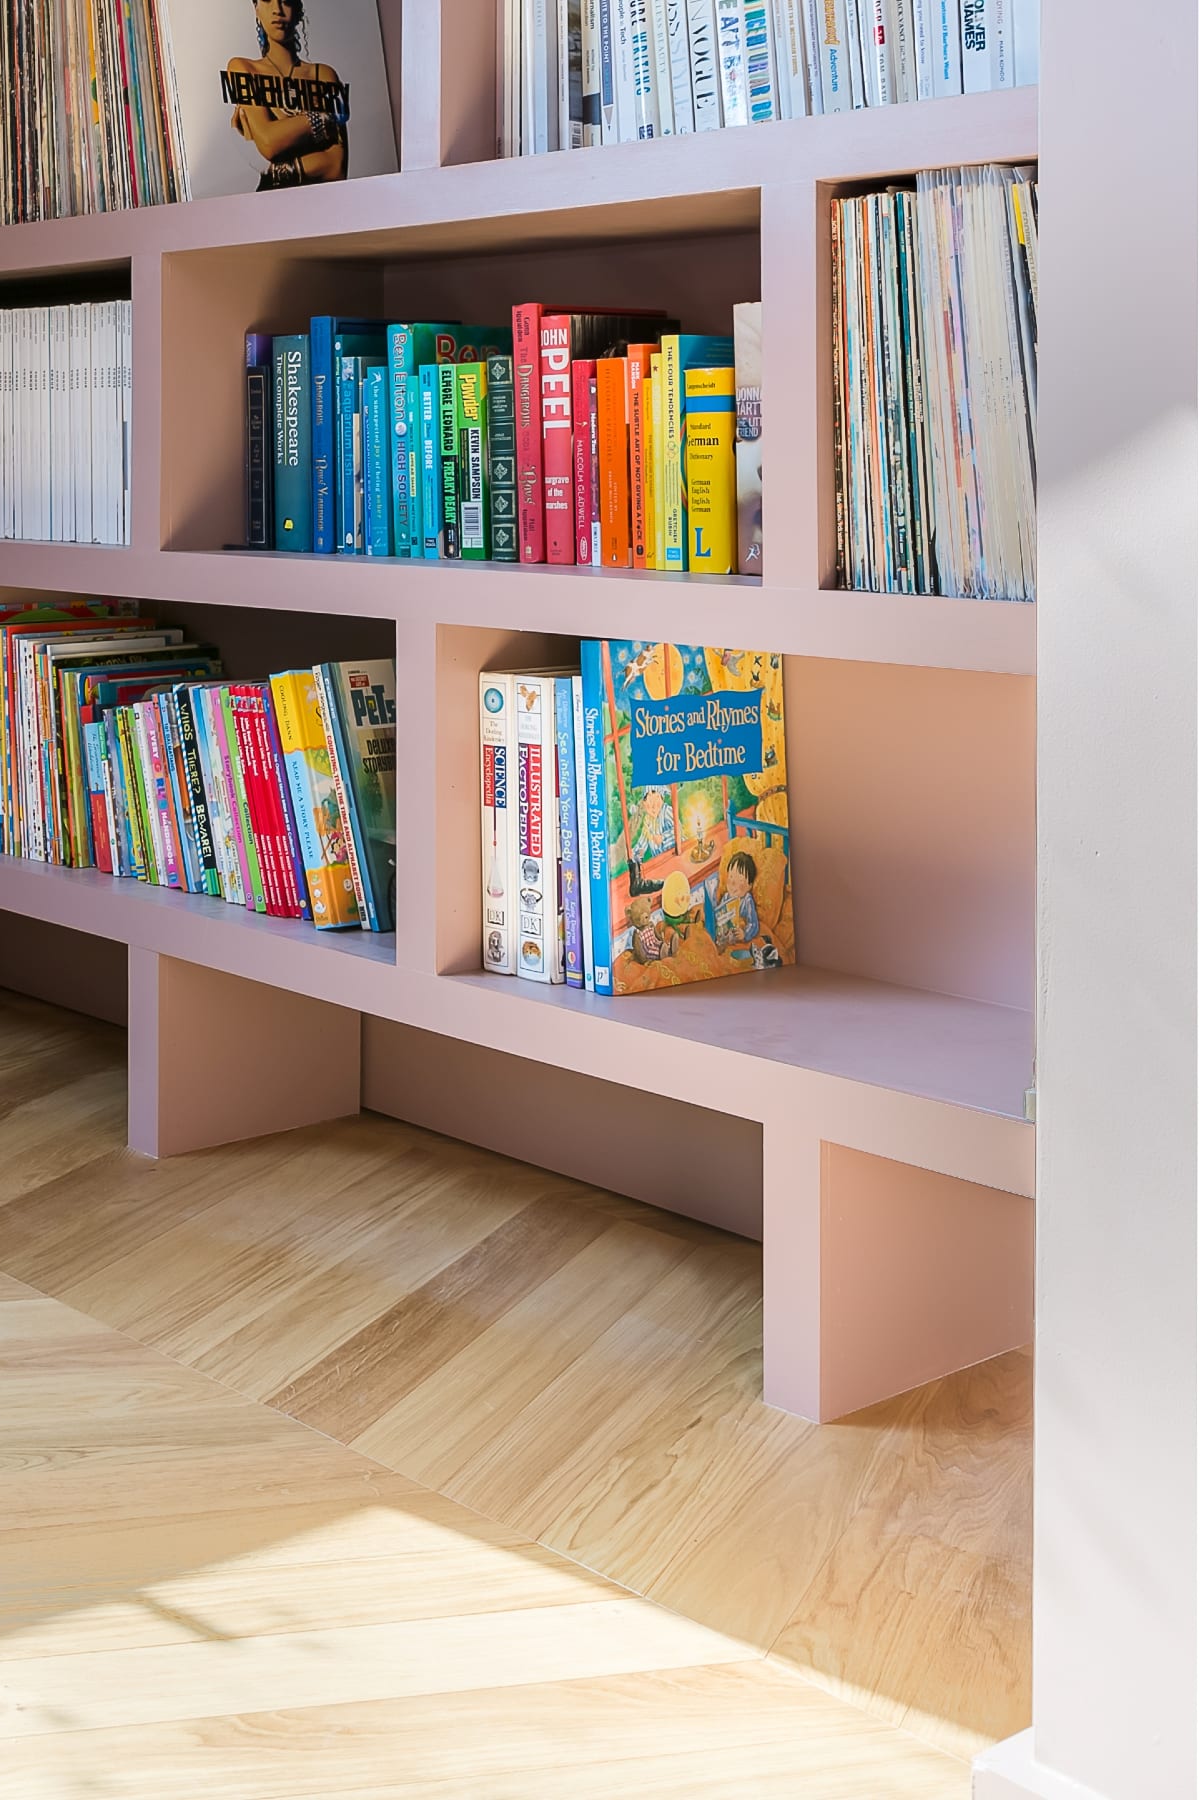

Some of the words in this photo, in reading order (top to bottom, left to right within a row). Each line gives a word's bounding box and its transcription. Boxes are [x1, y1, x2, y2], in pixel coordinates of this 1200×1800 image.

[601, 14, 607, 24] TO
[618, 26, 628, 44] Tech
[960, 0, 978, 50] JAMES
[969, 0, 990, 51] OLIVER
[630, 31, 652, 95] WRITING
[686, 23, 717, 109] VOGUE
[828, 47, 840, 92] Adventure
[219, 70, 283, 109] NENEH
[283, 76, 350, 113] CHERRY
[276, 355, 284, 374] The
[393, 333, 407, 368] Ben
[275, 376, 284, 429] Complete
[393, 371, 407, 421] Elton
[423, 391, 432, 420] BETTER
[441, 369, 453, 406] ELMORE
[459, 373, 479, 421] Powder
[541, 347, 571, 440] PEEL
[736, 387, 760, 401] DONN
[287, 351, 302, 467] Shakespeare
[632, 408, 640, 437] SUBTLE
[276, 430, 284, 464] Works
[442, 409, 454, 452] LEONARD
[470, 429, 480, 454] KEVIN
[344, 453, 352, 476] fish
[397, 441, 406, 471] HIGH
[425, 439, 433, 470] BEFORE
[576, 439, 584, 482] MALCOLM
[633, 454, 640, 465] OF
[443, 461, 455, 495] FREAKY
[471, 456, 481, 500] SAMPSON
[554, 488, 563, 497] the
[398, 474, 408, 527] SOCIETY
[577, 485, 585, 529] GLADWELL
[694, 527, 712, 557] L
[584, 706, 599, 747] Stories
[635, 705, 686, 738] Stories
[686, 706, 706, 727] and
[706, 699, 759, 733] Rhymes
[558, 731, 569, 755] See
[588, 747, 598, 763] and
[656, 745, 681, 775] for
[684, 738, 746, 772] Bedtime
[223, 755, 236, 799] Storybook
[291, 760, 301, 780] READ
[334, 773, 342, 792] TELL
[484, 746, 494, 805] Encyclopedia
[494, 745, 506, 809] SCIENCE
[559, 757, 570, 796] inside
[585, 761, 602, 806] Rhymes
[149, 730, 160, 759] EVERY
[161, 811, 175, 865] HANDBOOK
[187, 748, 202, 795] THERE?
[195, 804, 213, 859] BEWARE!
[298, 804, 309, 828] STORY
[336, 791, 344, 805] THE
[519, 747, 529, 851] FACTOPEDIA
[529, 745, 542, 856] ILLUSTRATED
[561, 796, 570, 827] Your
[242, 801, 254, 845] Collection
[342, 824, 351, 841] AND
[588, 808, 603, 828] for
[303, 830, 315, 859] PLEASE
[347, 842, 359, 880] ALPHABET
[561, 829, 573, 862] Body
[590, 830, 606, 880] Bedtime
[353, 881, 363, 902] BOOK
[523, 919, 538, 932] DK
